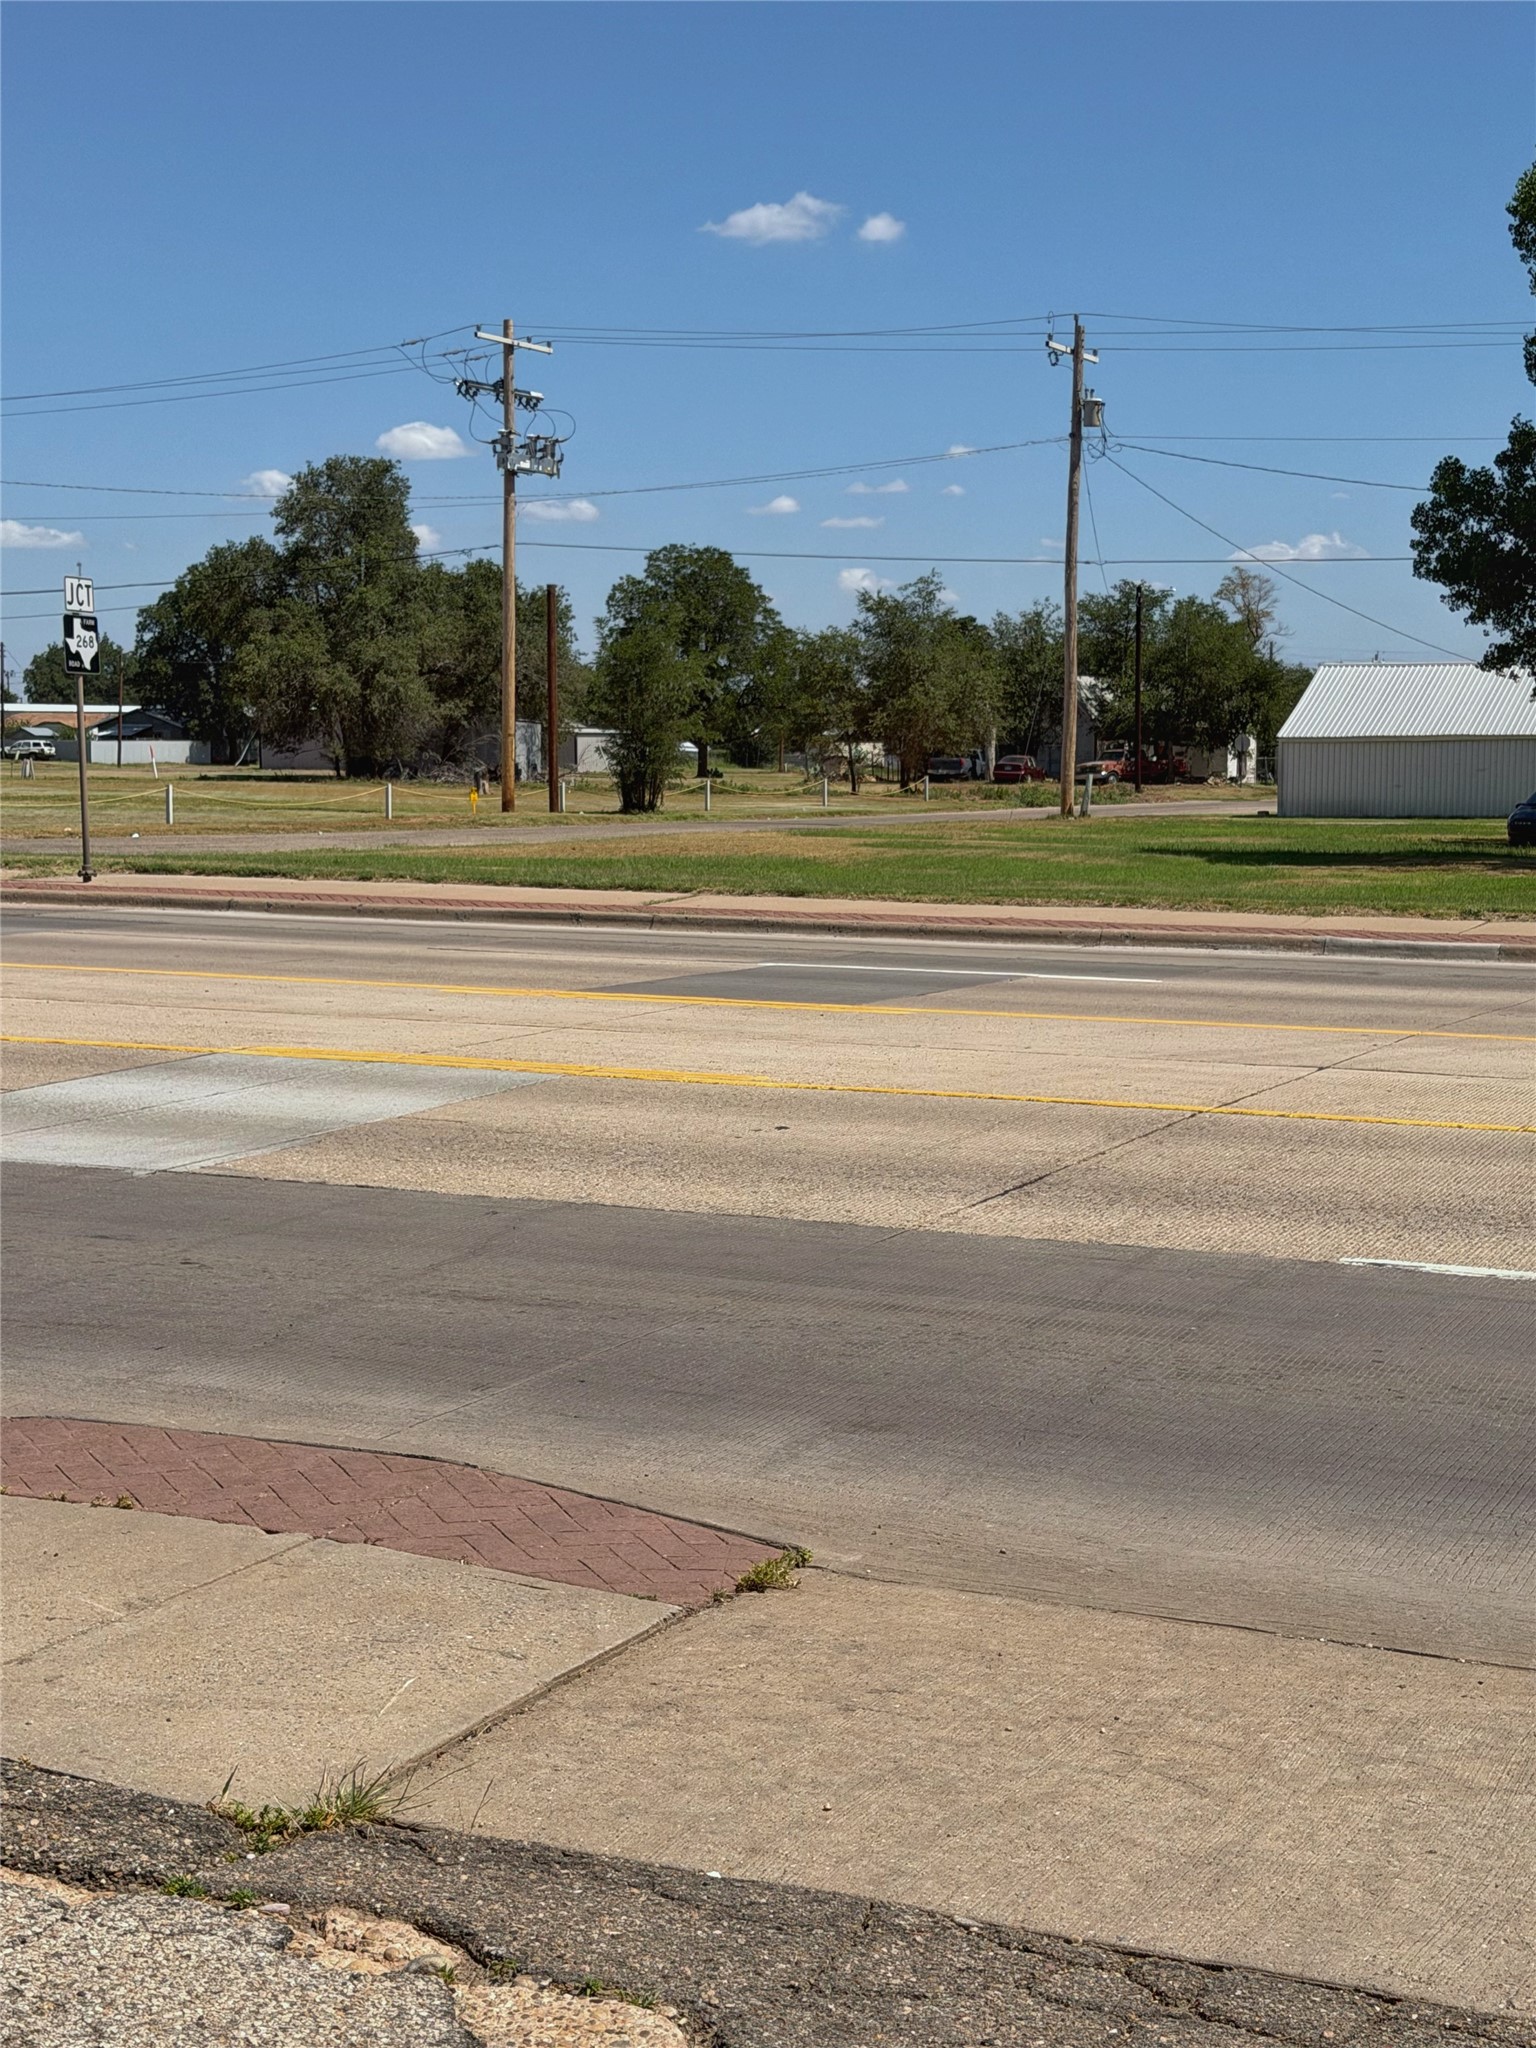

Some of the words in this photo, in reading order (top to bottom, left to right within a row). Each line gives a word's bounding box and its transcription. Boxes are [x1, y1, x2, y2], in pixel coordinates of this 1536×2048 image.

[67, 582, 91, 607] JCT
[76, 634, 95, 649] 268
[68, 659, 81, 668] ROAD
